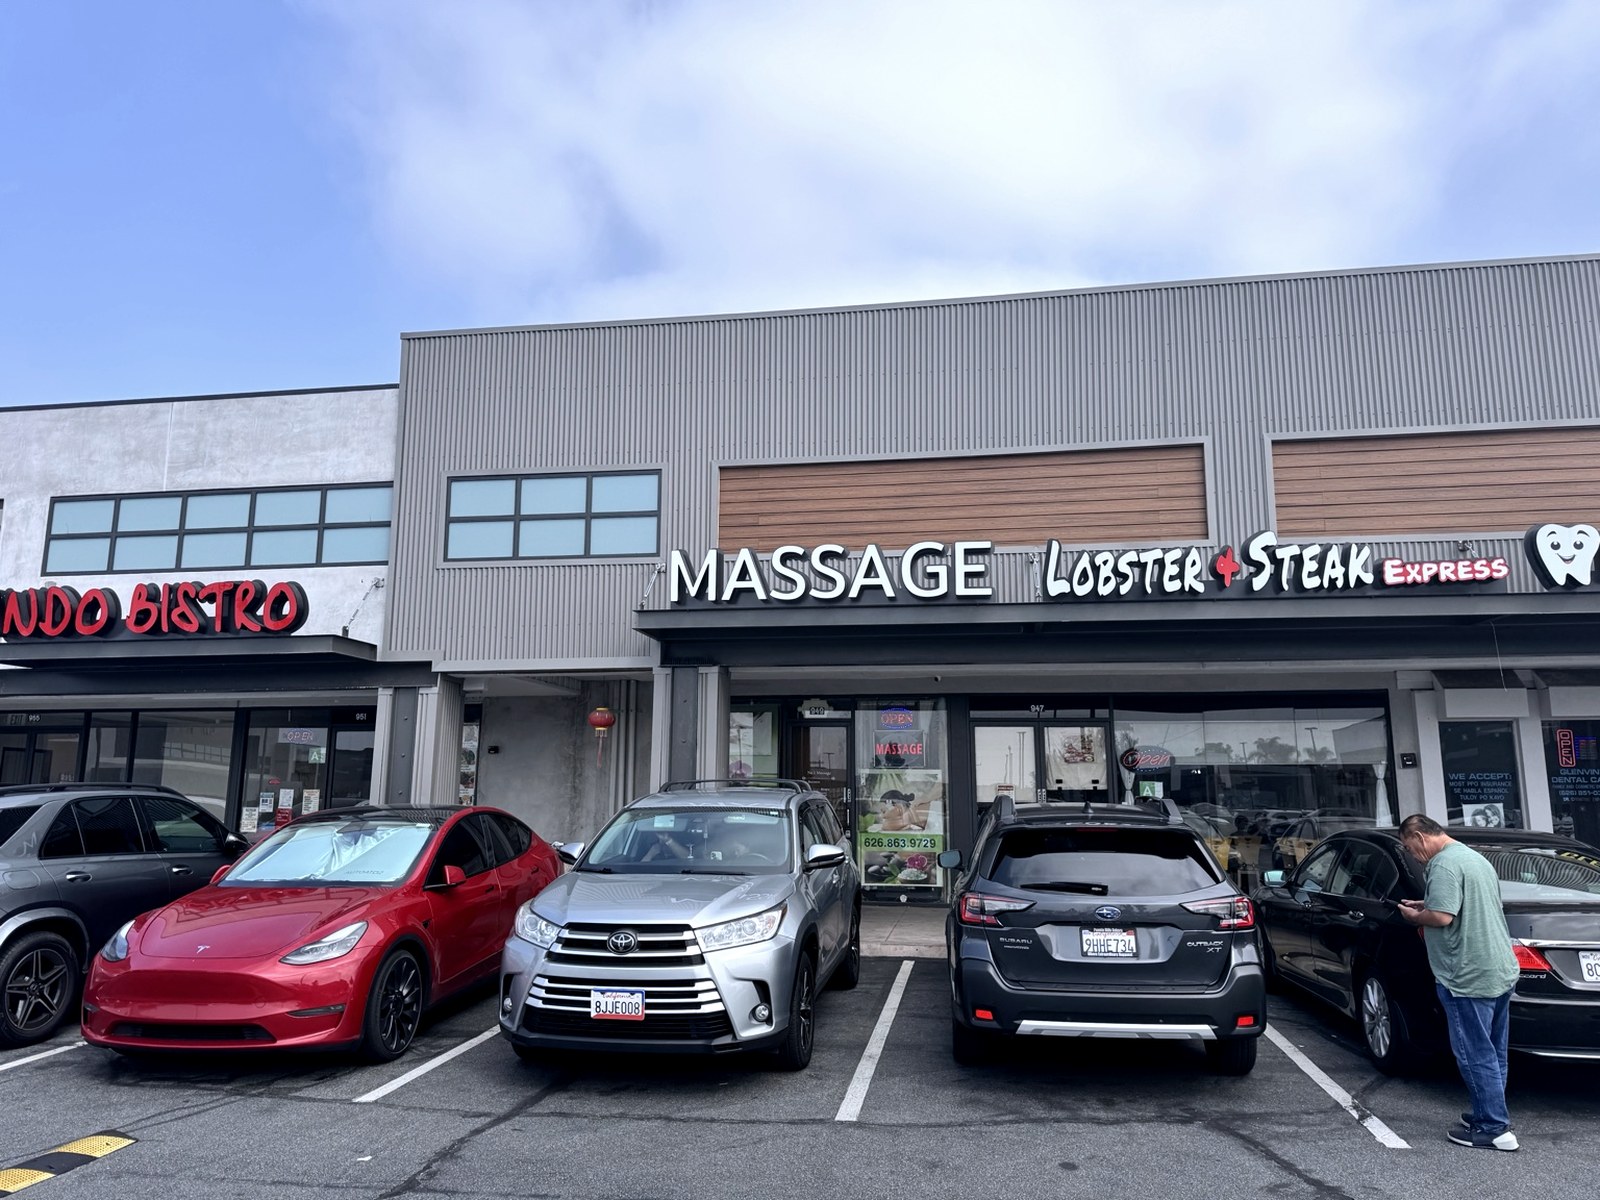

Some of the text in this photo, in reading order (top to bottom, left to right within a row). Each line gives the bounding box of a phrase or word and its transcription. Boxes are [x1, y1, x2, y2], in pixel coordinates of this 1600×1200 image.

[1046, 540, 1205, 597] LOBSTER
[1249, 531, 1374, 592] STEAK
[1383, 558, 1510, 586] EXPRESS
[669, 541, 994, 602] MASSAGE
[3, 580, 298, 637] NDO BISTRO
[880, 713, 913, 724] OPEN
[875, 743, 923, 755] MASSAGE
[1559, 731, 1573, 765] OPEN
[311, 752, 319, 761] A
[1123, 750, 1170, 769] Open
[1448, 772, 1466, 780] WE
[1142, 785, 1153, 796] A
[864, 837, 936, 848] 626.863.9729
[595, 1000, 640, 1015] 8JJE008
